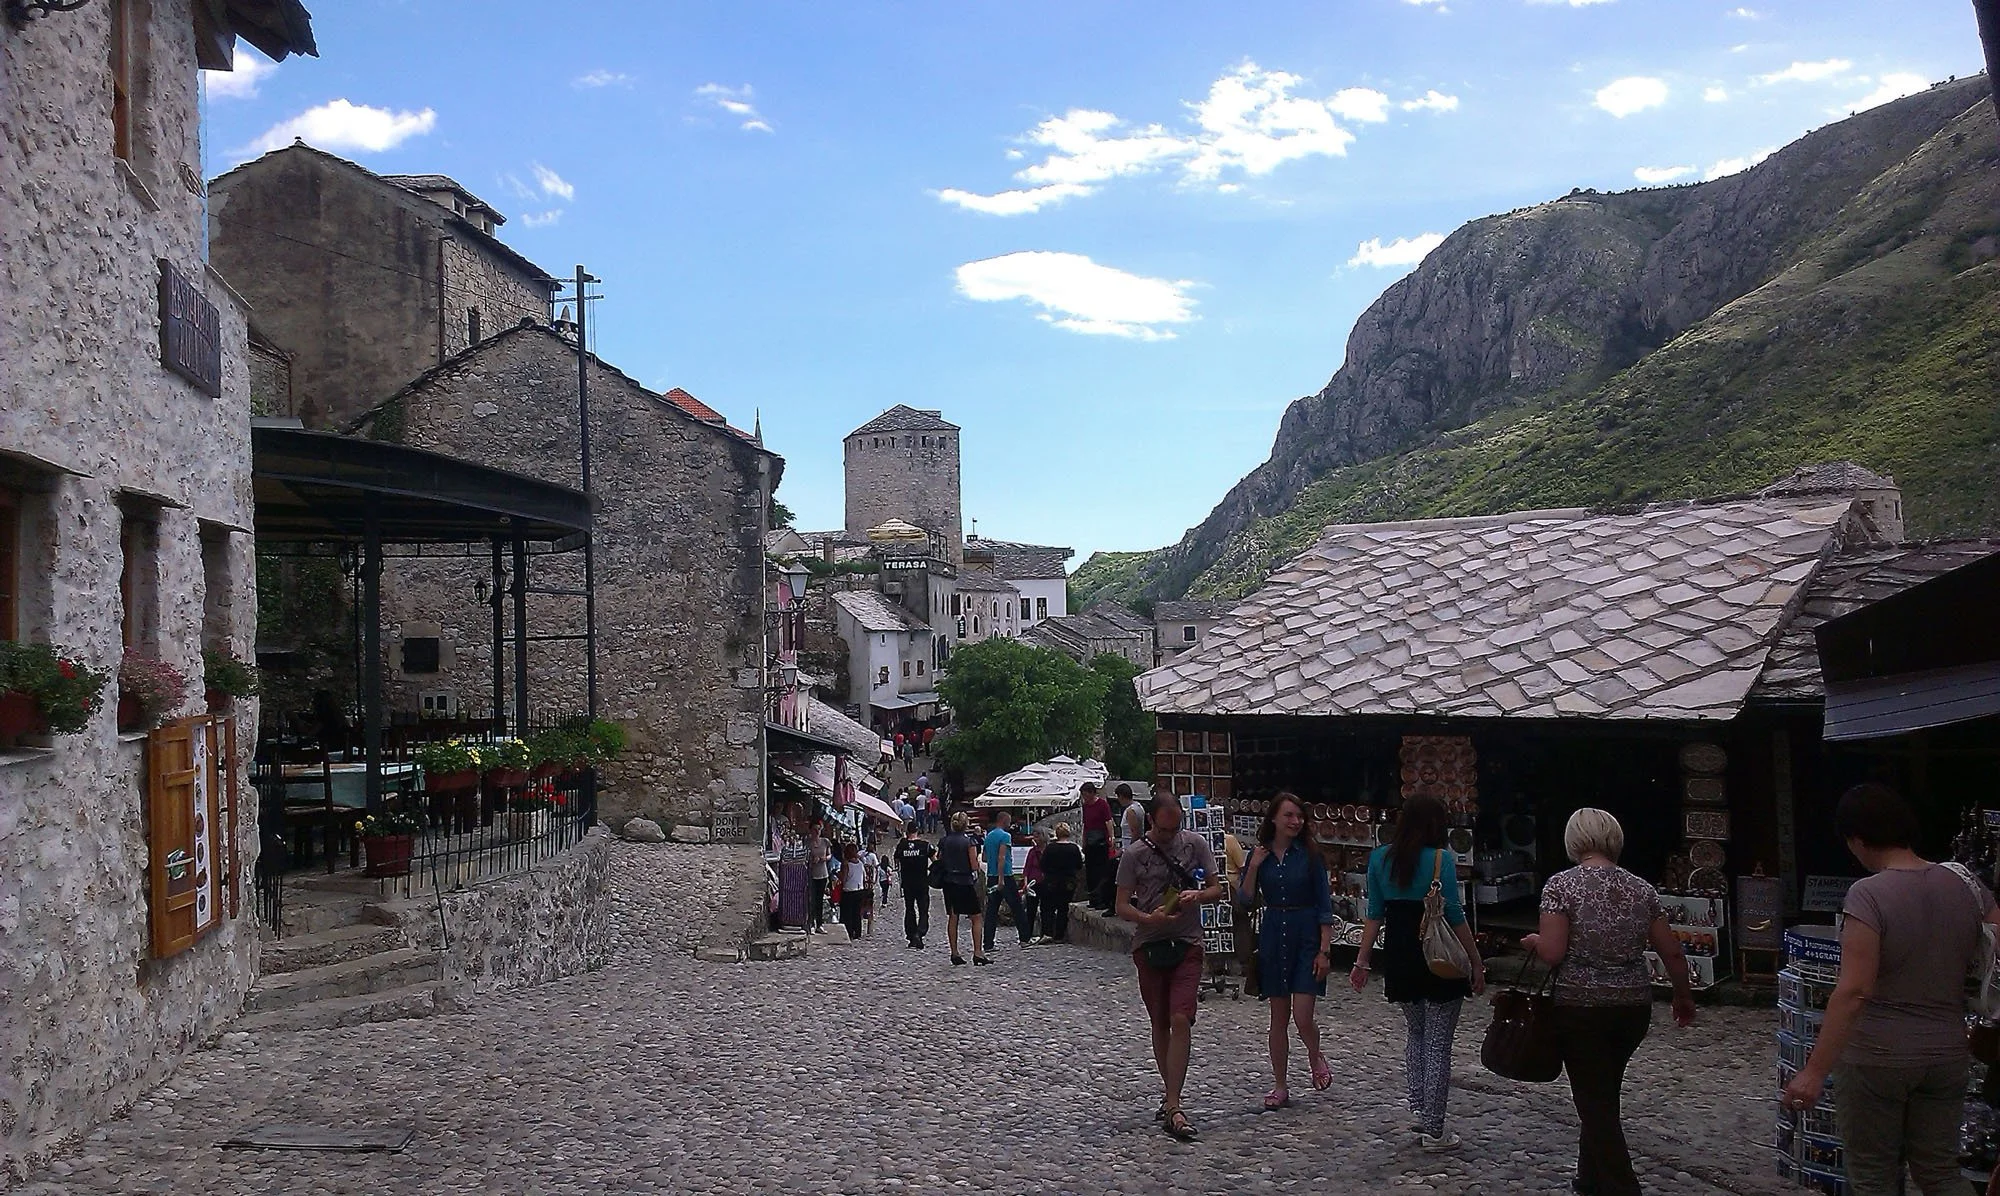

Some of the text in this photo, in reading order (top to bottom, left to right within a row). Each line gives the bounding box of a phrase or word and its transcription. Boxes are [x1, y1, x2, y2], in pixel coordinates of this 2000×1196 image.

[884, 561, 927, 569] TERASA
[716, 827, 747, 837] FORGET
[903, 849, 920, 857] BMW
